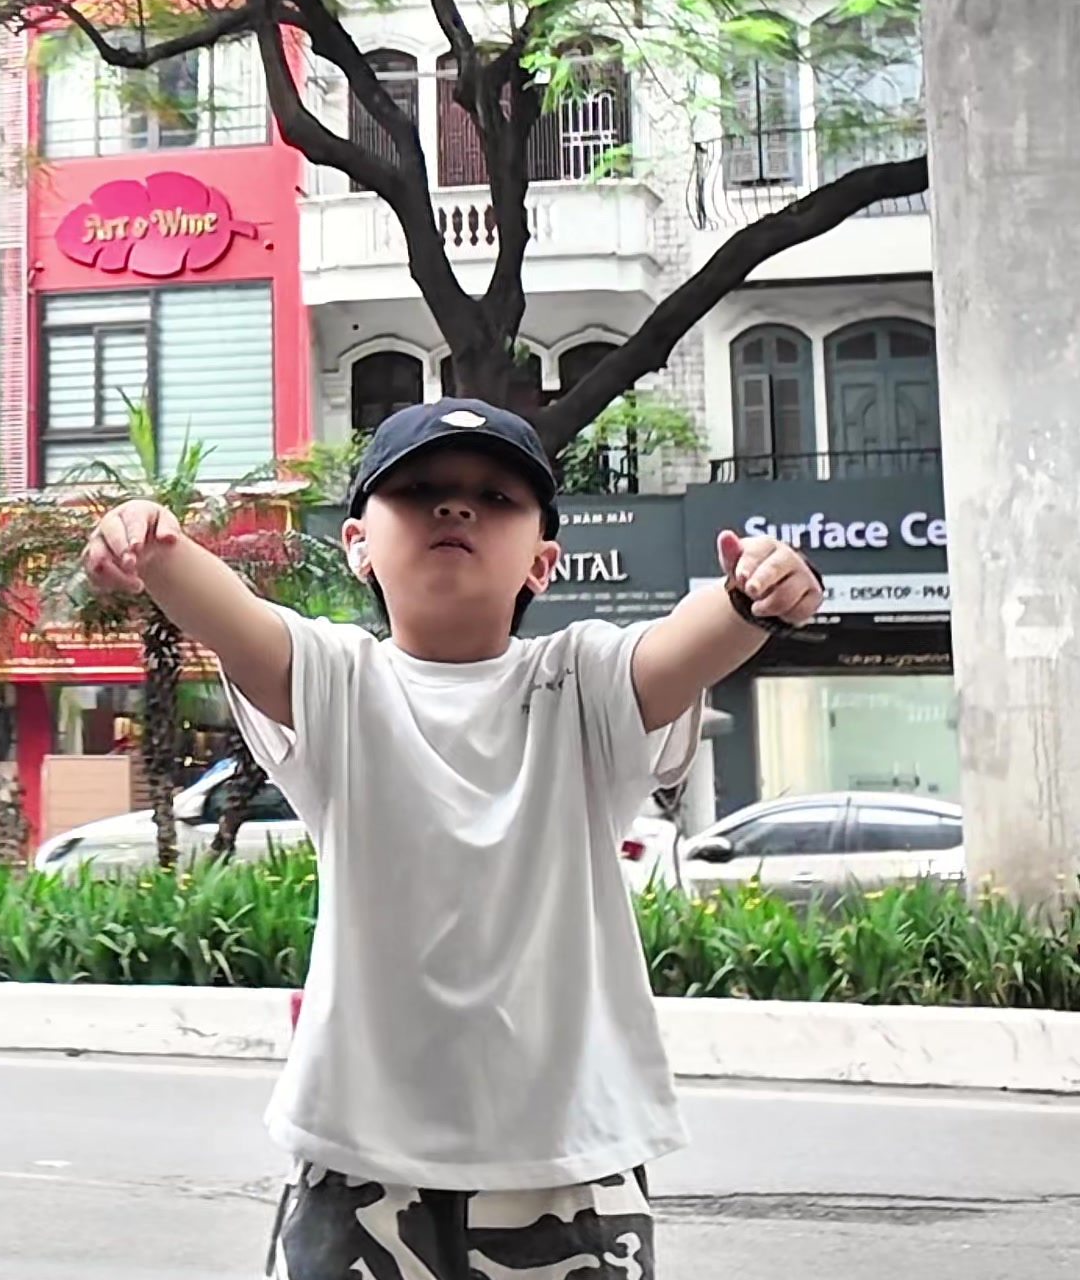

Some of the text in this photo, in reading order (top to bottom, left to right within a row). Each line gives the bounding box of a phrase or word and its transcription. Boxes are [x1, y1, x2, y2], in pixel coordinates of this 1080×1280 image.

[149, 206, 220, 238] Wine
[744, 511, 948, 549] Surface Ce
[550, 549, 629, 582] NTAL
[849, 585, 912, 601] DESKTOP
